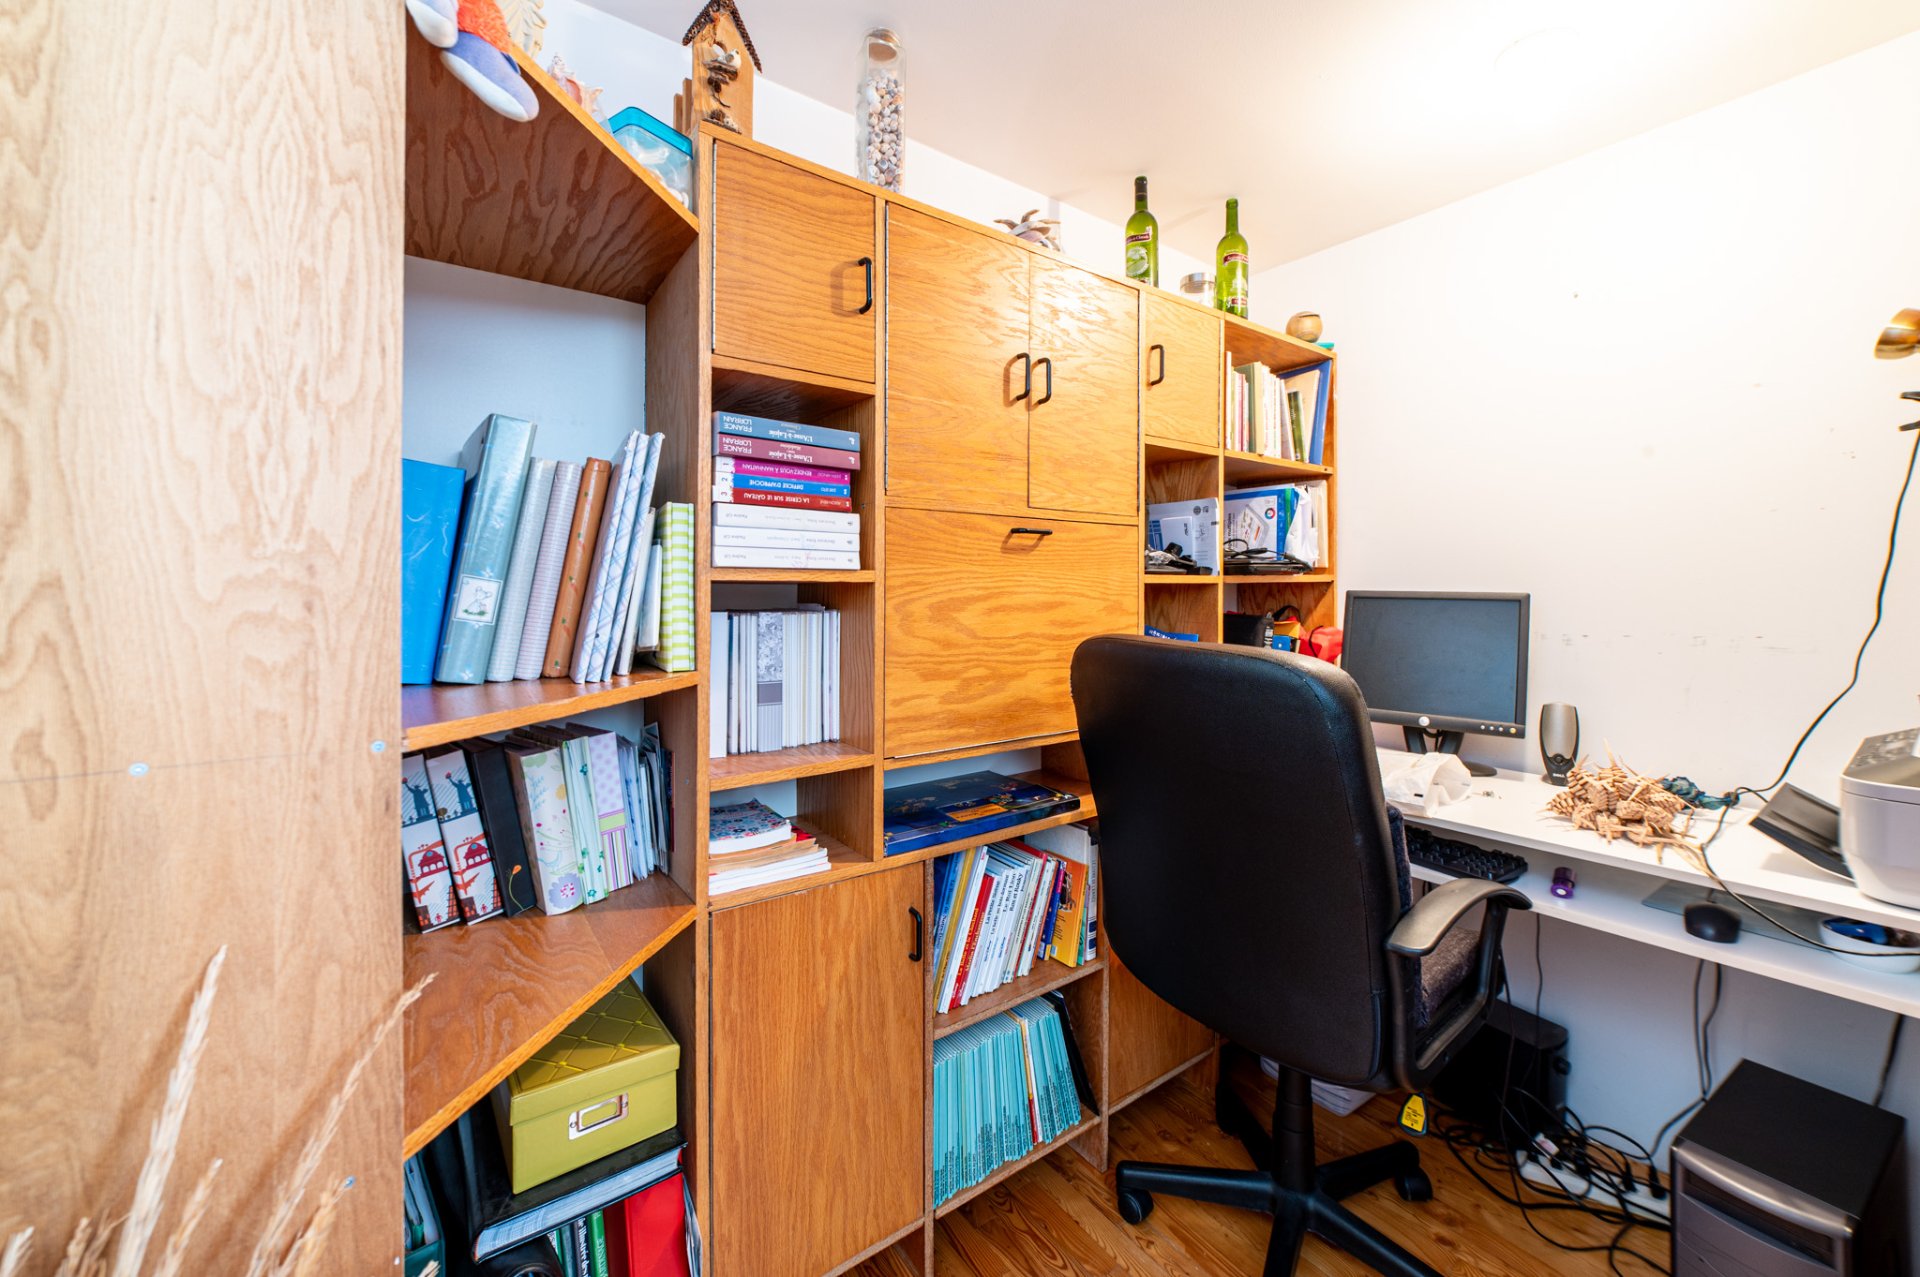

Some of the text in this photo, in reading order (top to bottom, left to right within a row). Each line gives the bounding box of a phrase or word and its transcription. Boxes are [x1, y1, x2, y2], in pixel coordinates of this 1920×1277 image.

[723, 416, 752, 425] LORRAIN
[724, 423, 752, 433] FRANCE
[722, 437, 752, 446] LORRAIN
[723, 445, 752, 454] FRANCE
[742, 463, 774, 472] MANHATTAN
[750, 479, 782, 488] D'APPROCHE
[743, 491, 766, 500] GÂTEAU
[773, 494, 784, 502] SUR
[1014, 873, 1023, 892] Rouky
